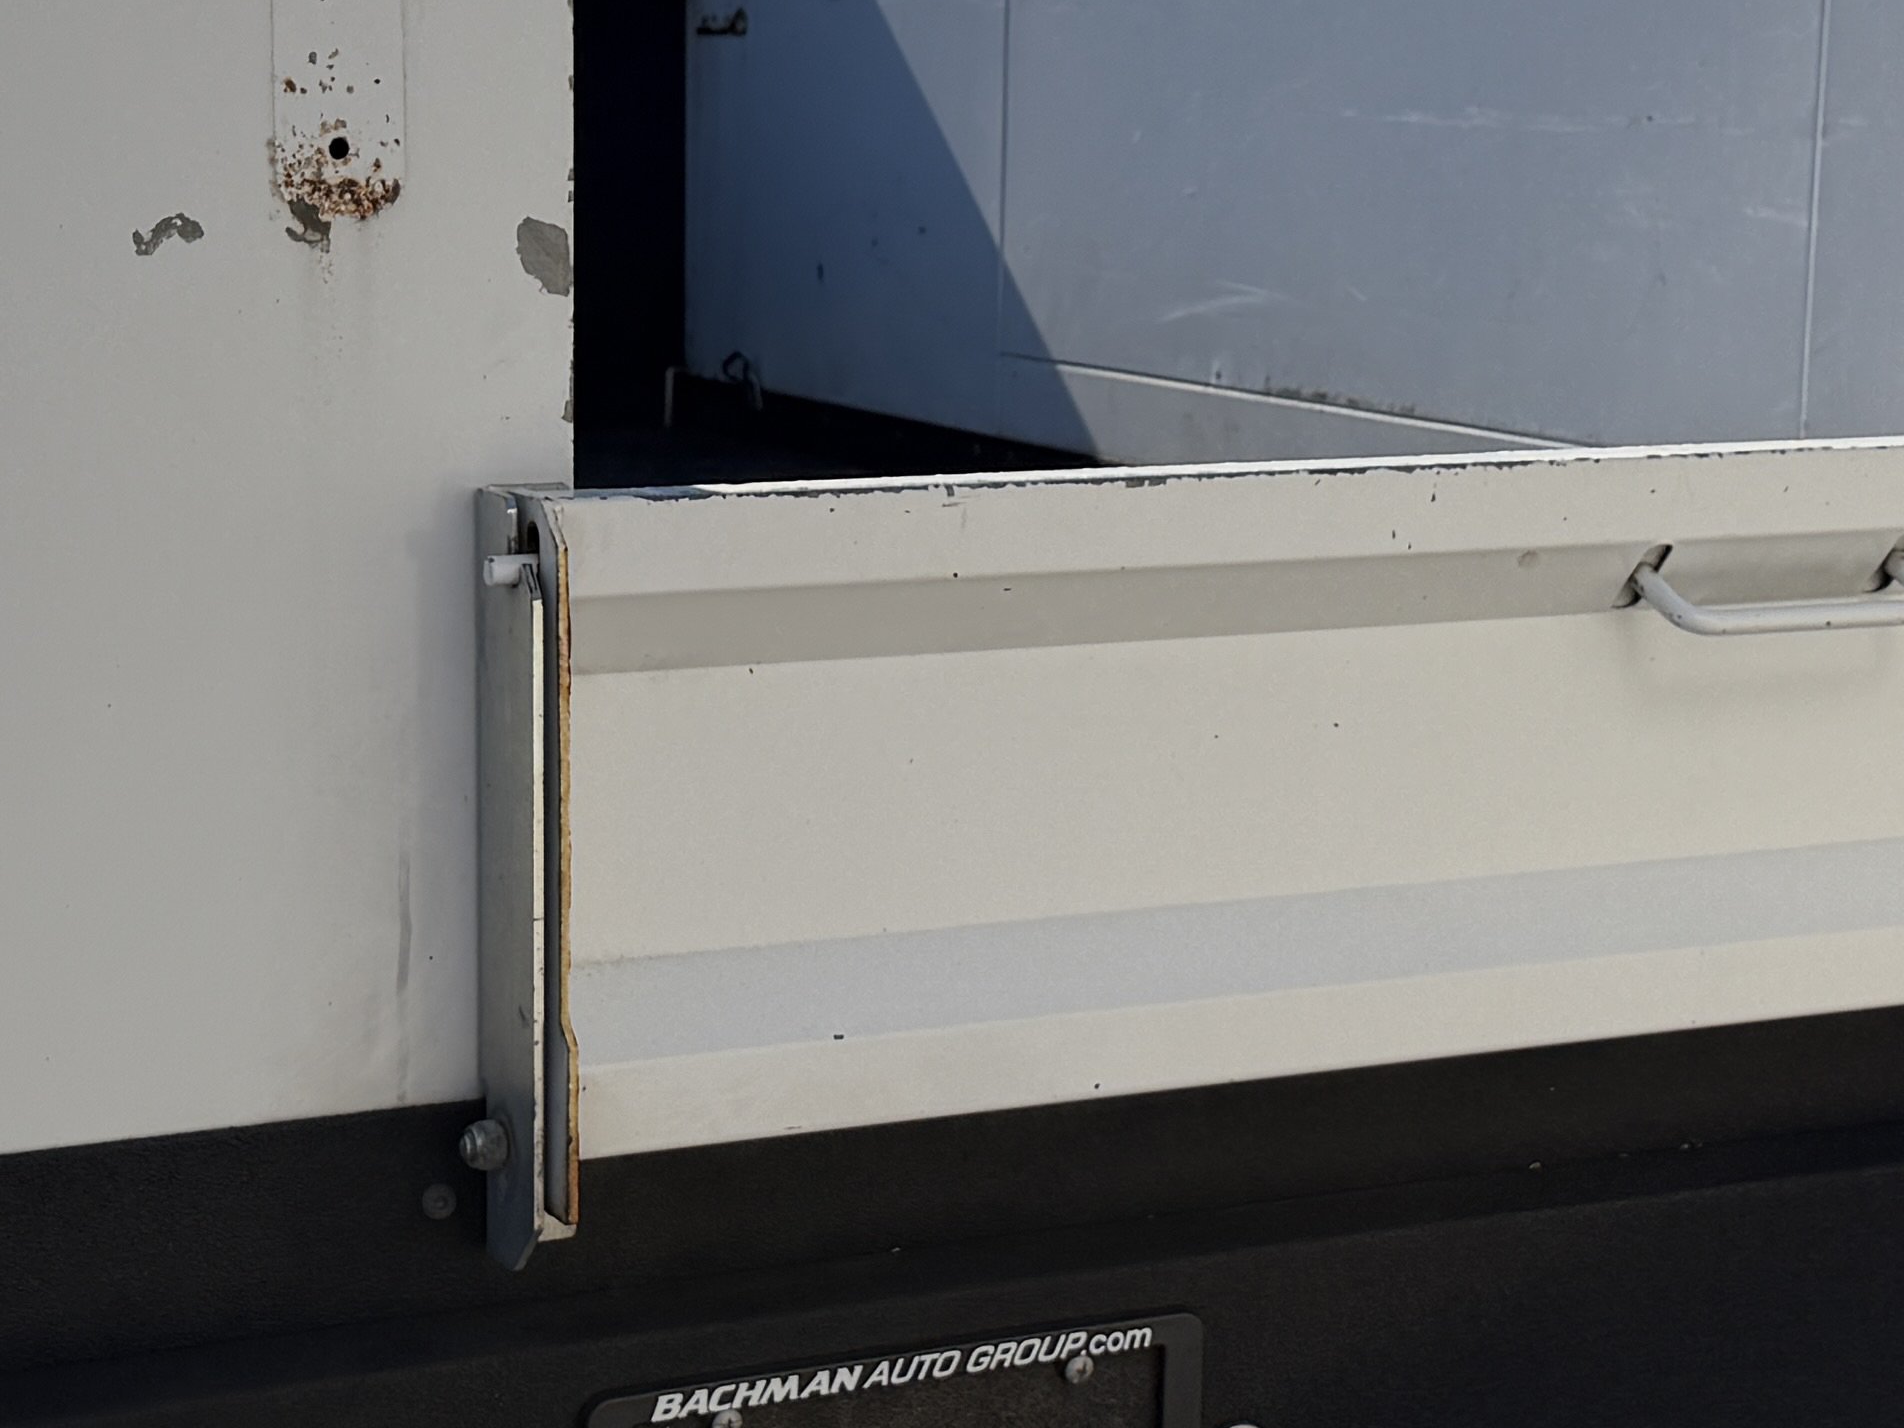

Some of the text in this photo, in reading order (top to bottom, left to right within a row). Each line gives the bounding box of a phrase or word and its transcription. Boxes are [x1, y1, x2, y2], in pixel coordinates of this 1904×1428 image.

[651, 1326, 1153, 1423] BACHMAN AUTO GROUP.com
